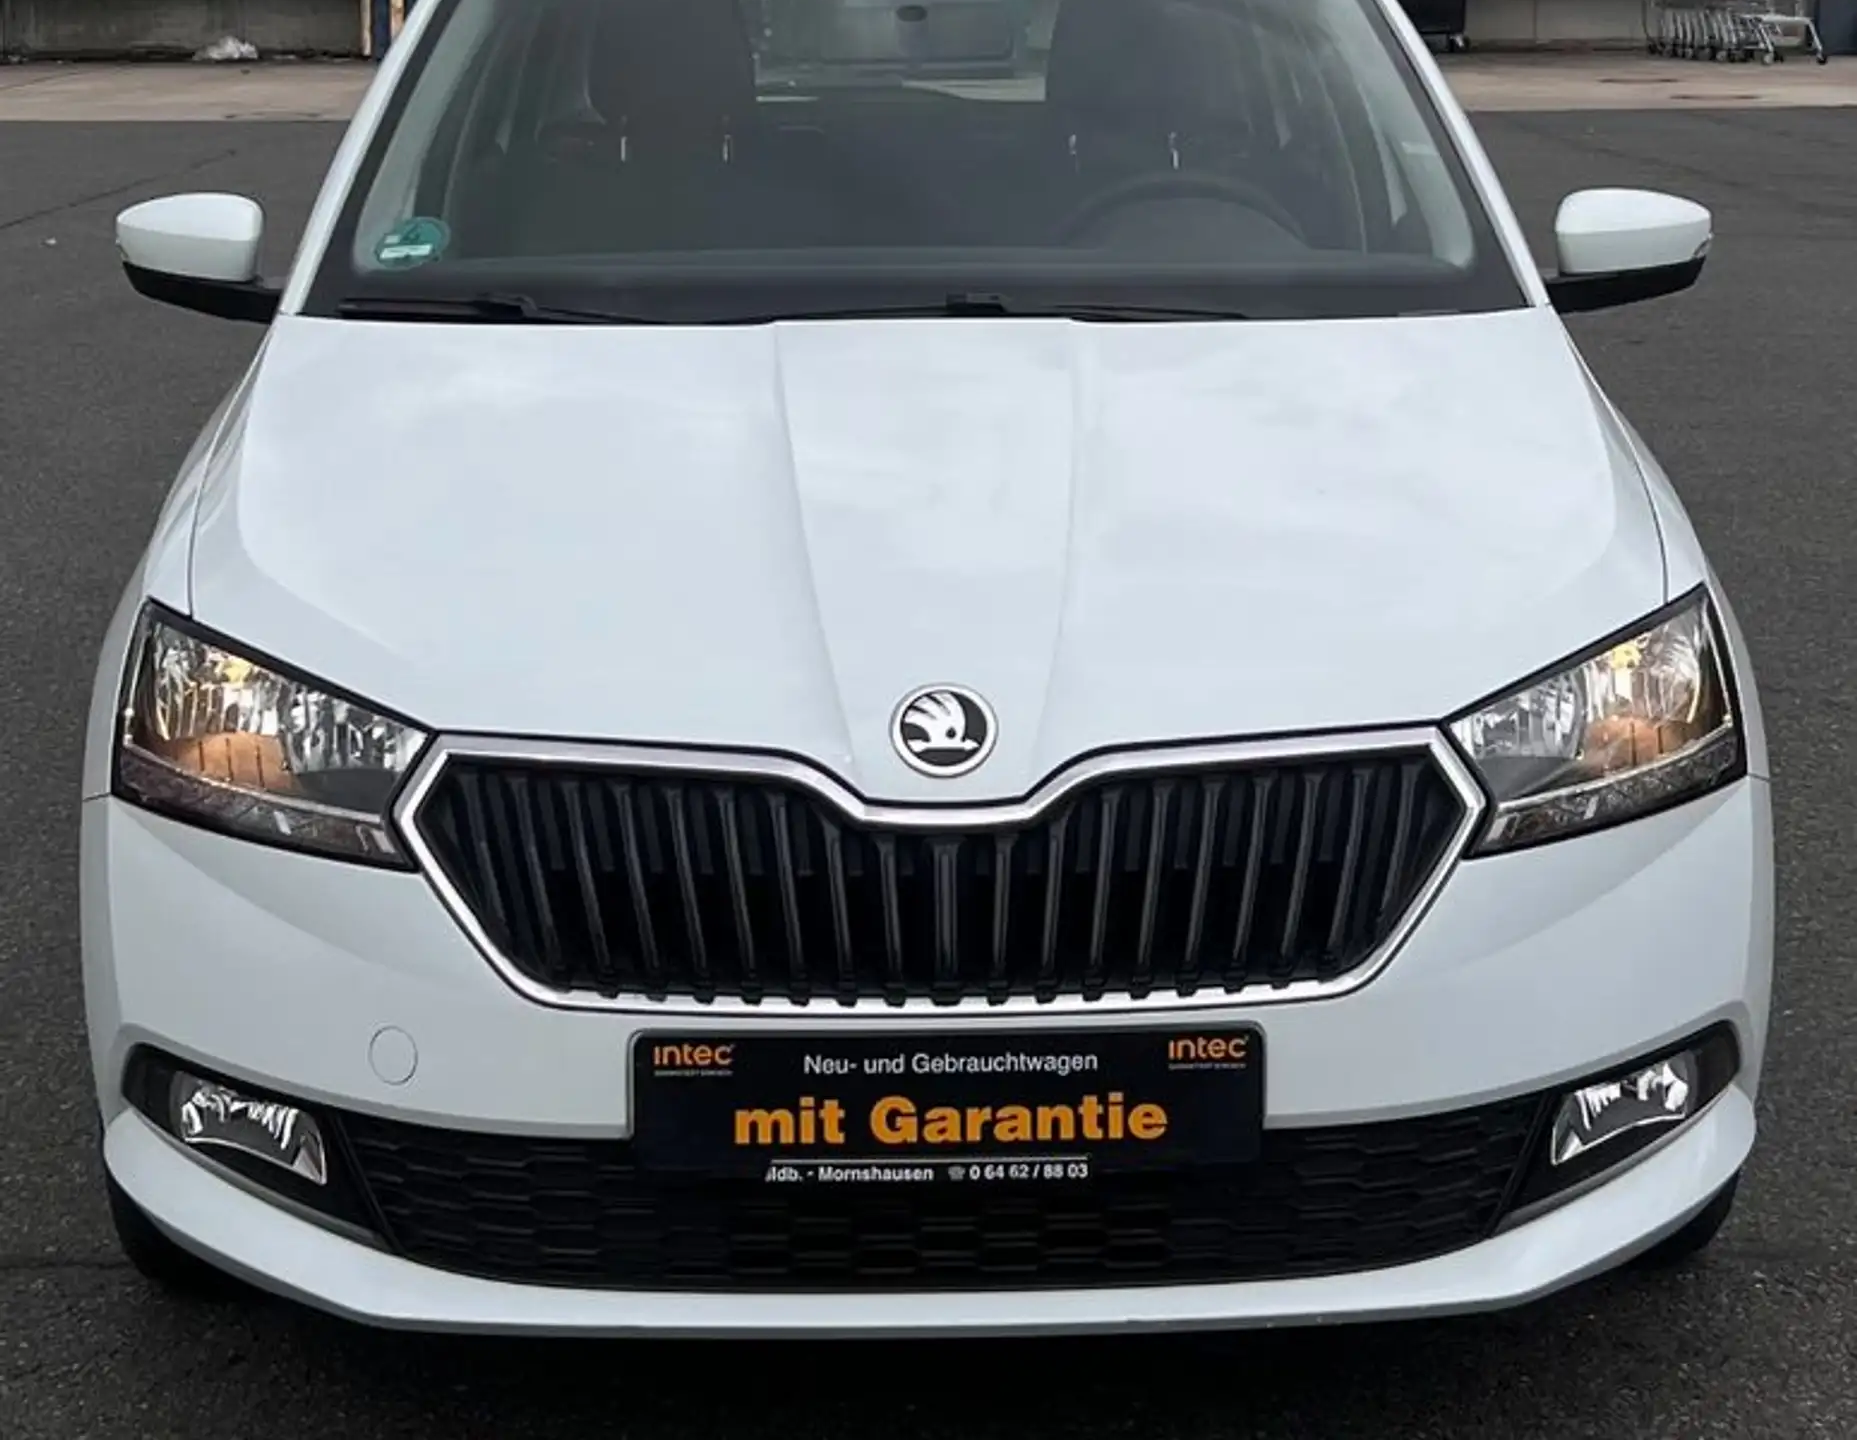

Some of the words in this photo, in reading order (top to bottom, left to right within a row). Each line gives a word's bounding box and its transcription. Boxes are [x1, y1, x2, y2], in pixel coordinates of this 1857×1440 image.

[654, 1044, 735, 1066] intec
[1168, 1036, 1248, 1059] intec
[803, 1054, 857, 1074] Neu-
[863, 1053, 905, 1074] und
[911, 1051, 1098, 1076] Gebrauchtwagen
[734, 1096, 845, 1144] mit
[869, 1092, 1168, 1144] Garantie
[818, 1166, 935, 1182] Mornshausen
[969, 1164, 981, 1180] 0
[1067, 1162, 1089, 1179] 03
